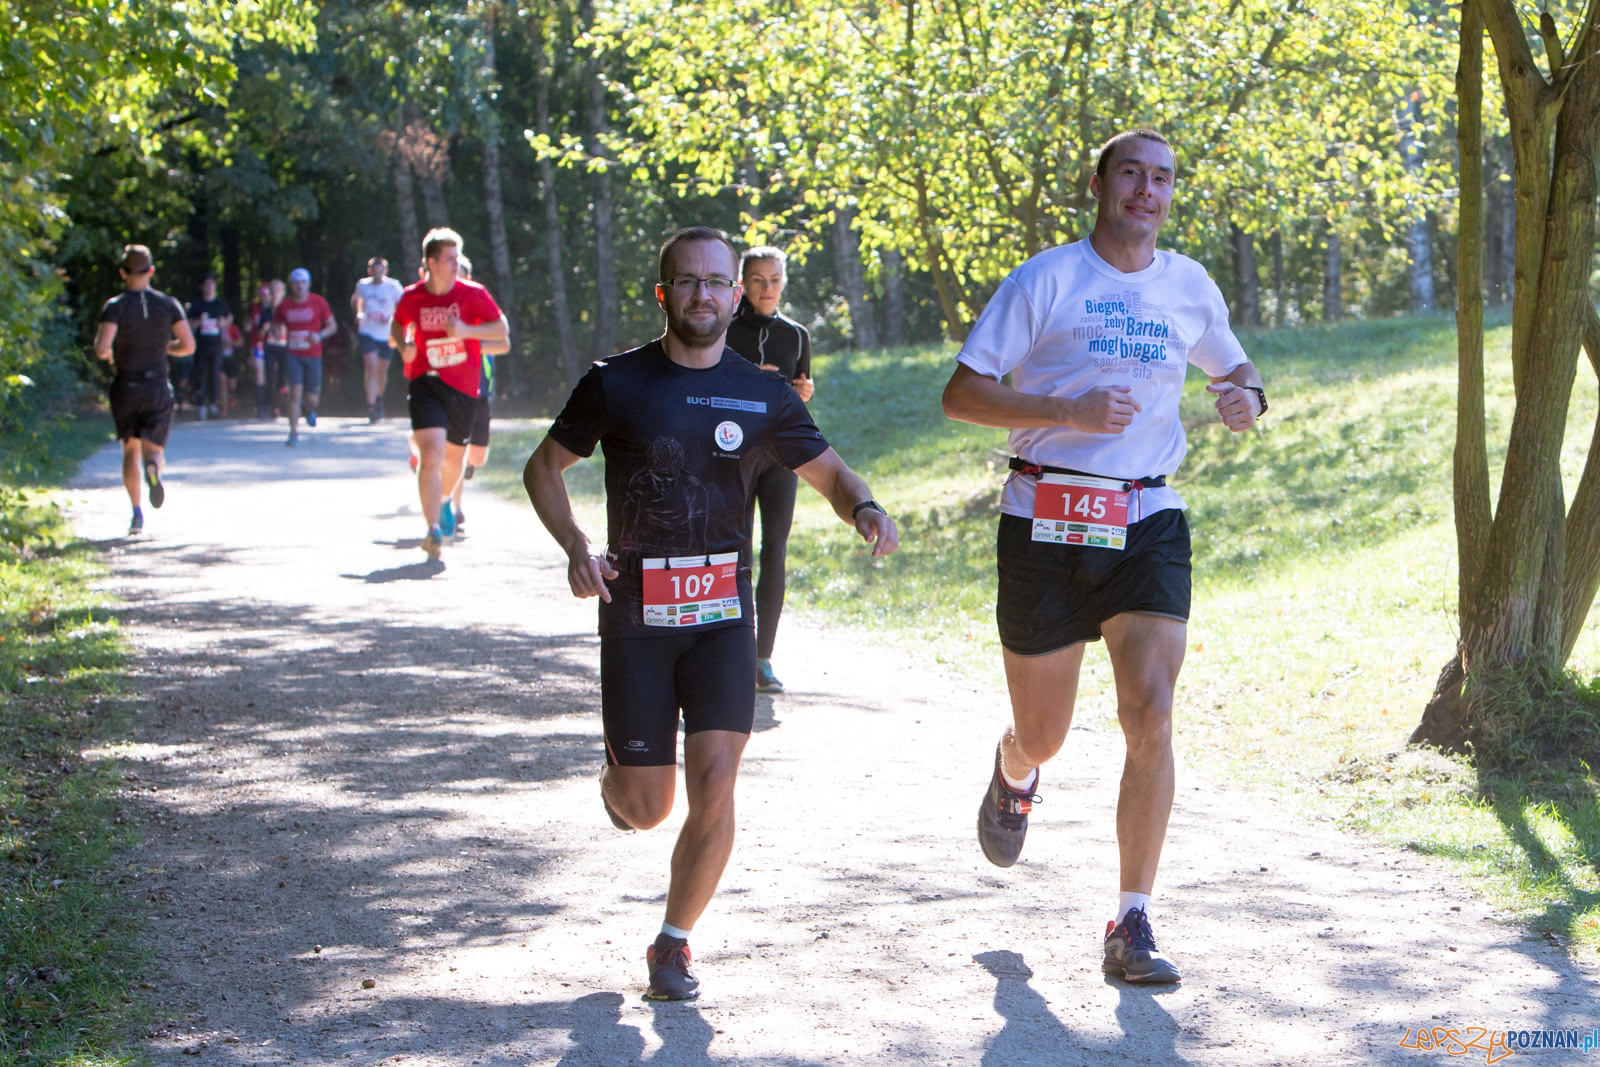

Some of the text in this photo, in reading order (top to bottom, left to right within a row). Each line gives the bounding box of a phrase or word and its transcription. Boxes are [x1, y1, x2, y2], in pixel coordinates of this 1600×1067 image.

[1085, 299, 1129, 316] Biegnę,
[1072, 325, 1103, 340] moc
[1104, 315, 1168, 338] żeby Bartek
[1120, 338, 1167, 363] biegać
[1061, 492, 1107, 519] 145
[670, 573, 715, 599] 109
